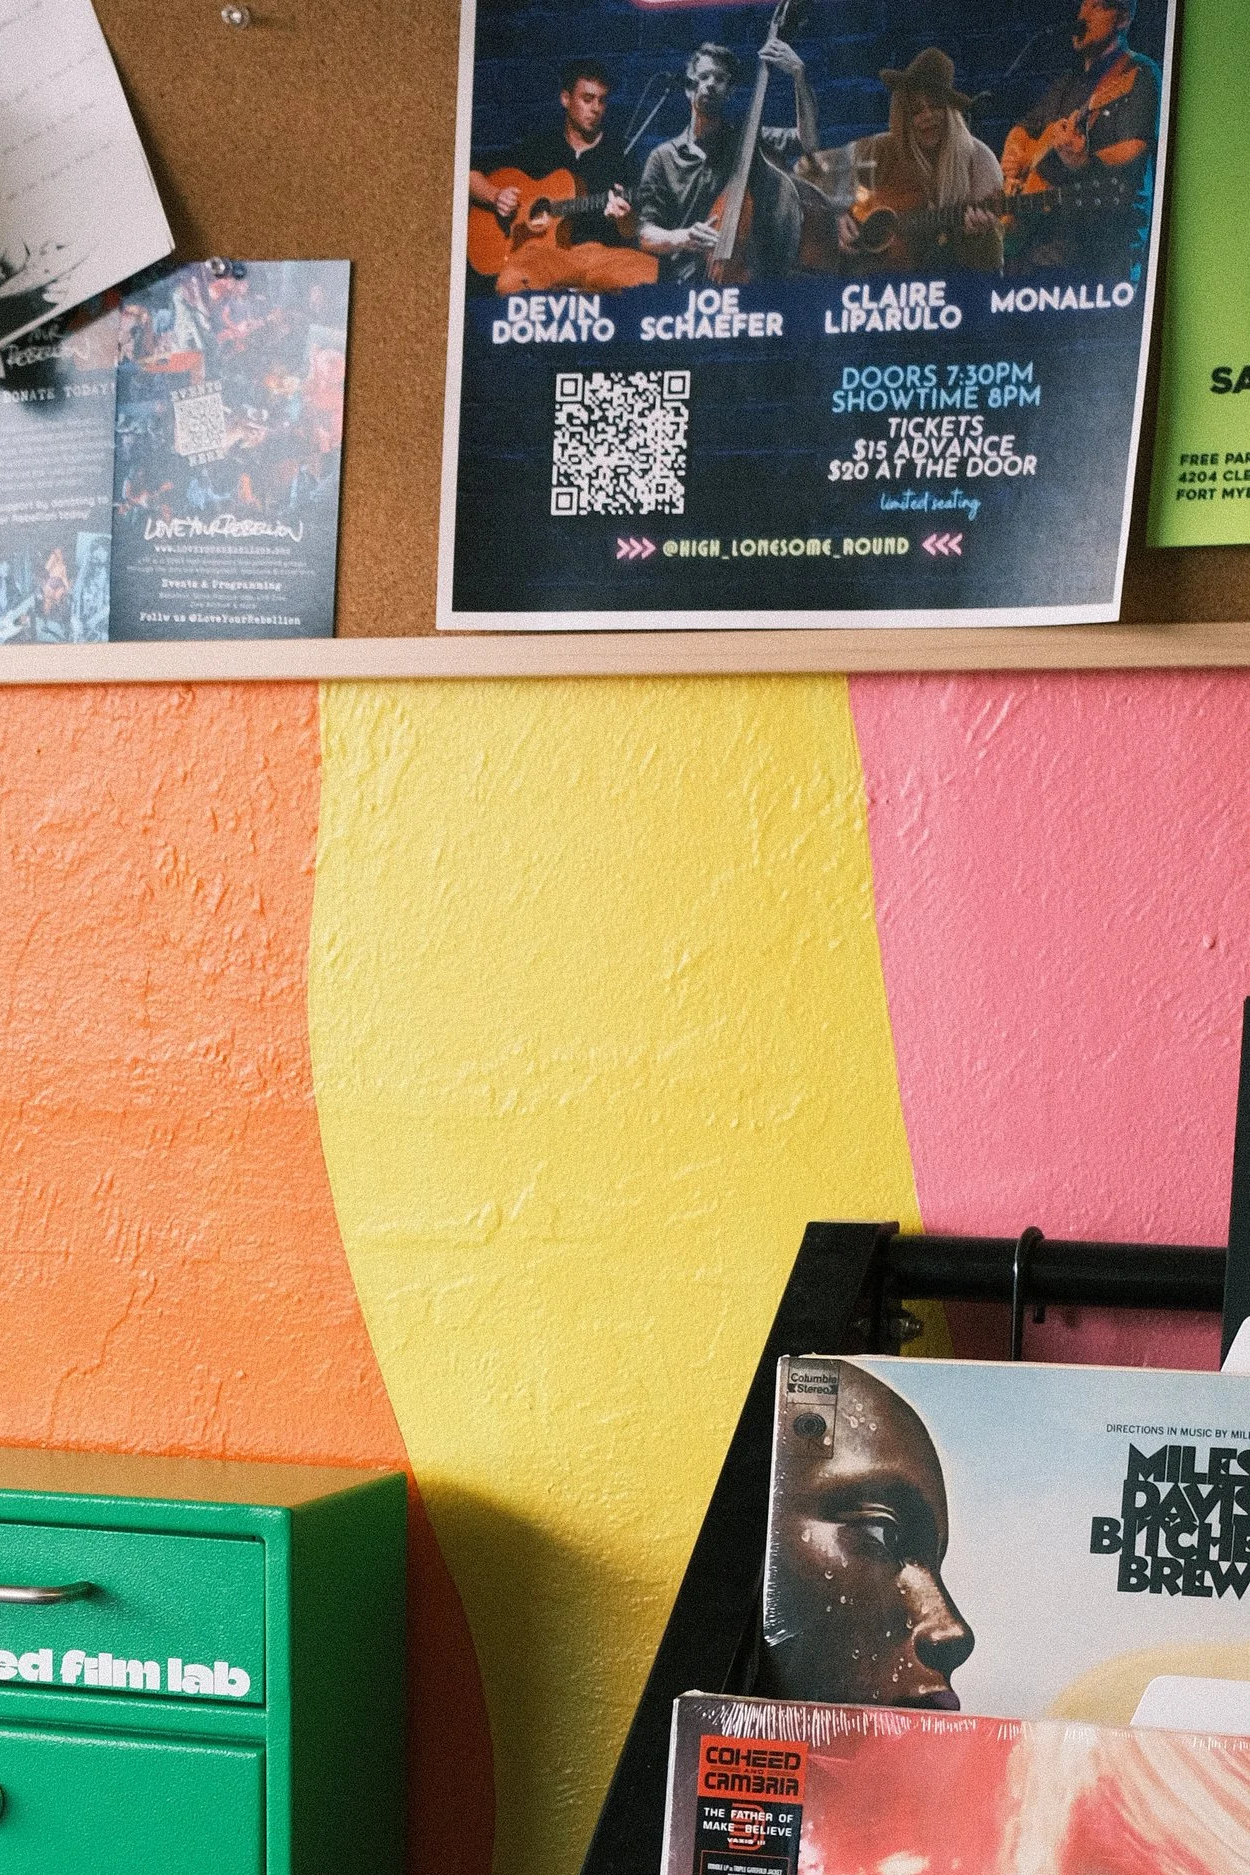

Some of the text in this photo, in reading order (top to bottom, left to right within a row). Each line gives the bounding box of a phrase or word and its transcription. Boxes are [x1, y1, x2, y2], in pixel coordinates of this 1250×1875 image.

[687, 287, 741, 318] JOE
[841, 280, 947, 309] CLAIRE
[989, 281, 1135, 314] MONALLO
[507, 294, 601, 322] DEVIN
[824, 304, 963, 334] LIPARULO
[491, 318, 616, 345] DOMATO
[639, 311, 784, 341] SCHAEFER
[841, 361, 1034, 391] DOORS 7:30PM
[2, 387, 56, 403] DONATE
[831, 383, 1042, 414] SHOWTIME 8PM
[887, 415, 985, 438] TICKETS
[852, 434, 1016, 461] $15 ADVANCE
[1179, 453, 1220, 466] FREE
[827, 454, 1038, 482] $20 AT THE DOOR
[1178, 470, 1218, 484] 4204
[879, 486, 982, 521] limited seating
[1175, 487, 1217, 501] FORT
[161, 578, 198, 589] Events
[211, 579, 283, 592] Programming
[173, 613, 187, 623] us
[790, 1372, 838, 1384] Columbia
[796, 1383, 831, 1394] Stereo
[1106, 1424, 1228, 1439] DIRECTIONS IN MUSIC BY
[1117, 1554, 1250, 1600] BREW
[59, 1649, 161, 1691] film
[167, 1655, 251, 1698] lab
[706, 1746, 802, 1771] COHEED
[703, 1771, 800, 1797] CAMBRIA
[702, 1820, 793, 1837] MAKE BELIEVE
[703, 1807, 794, 1824] THE FATHER OF
